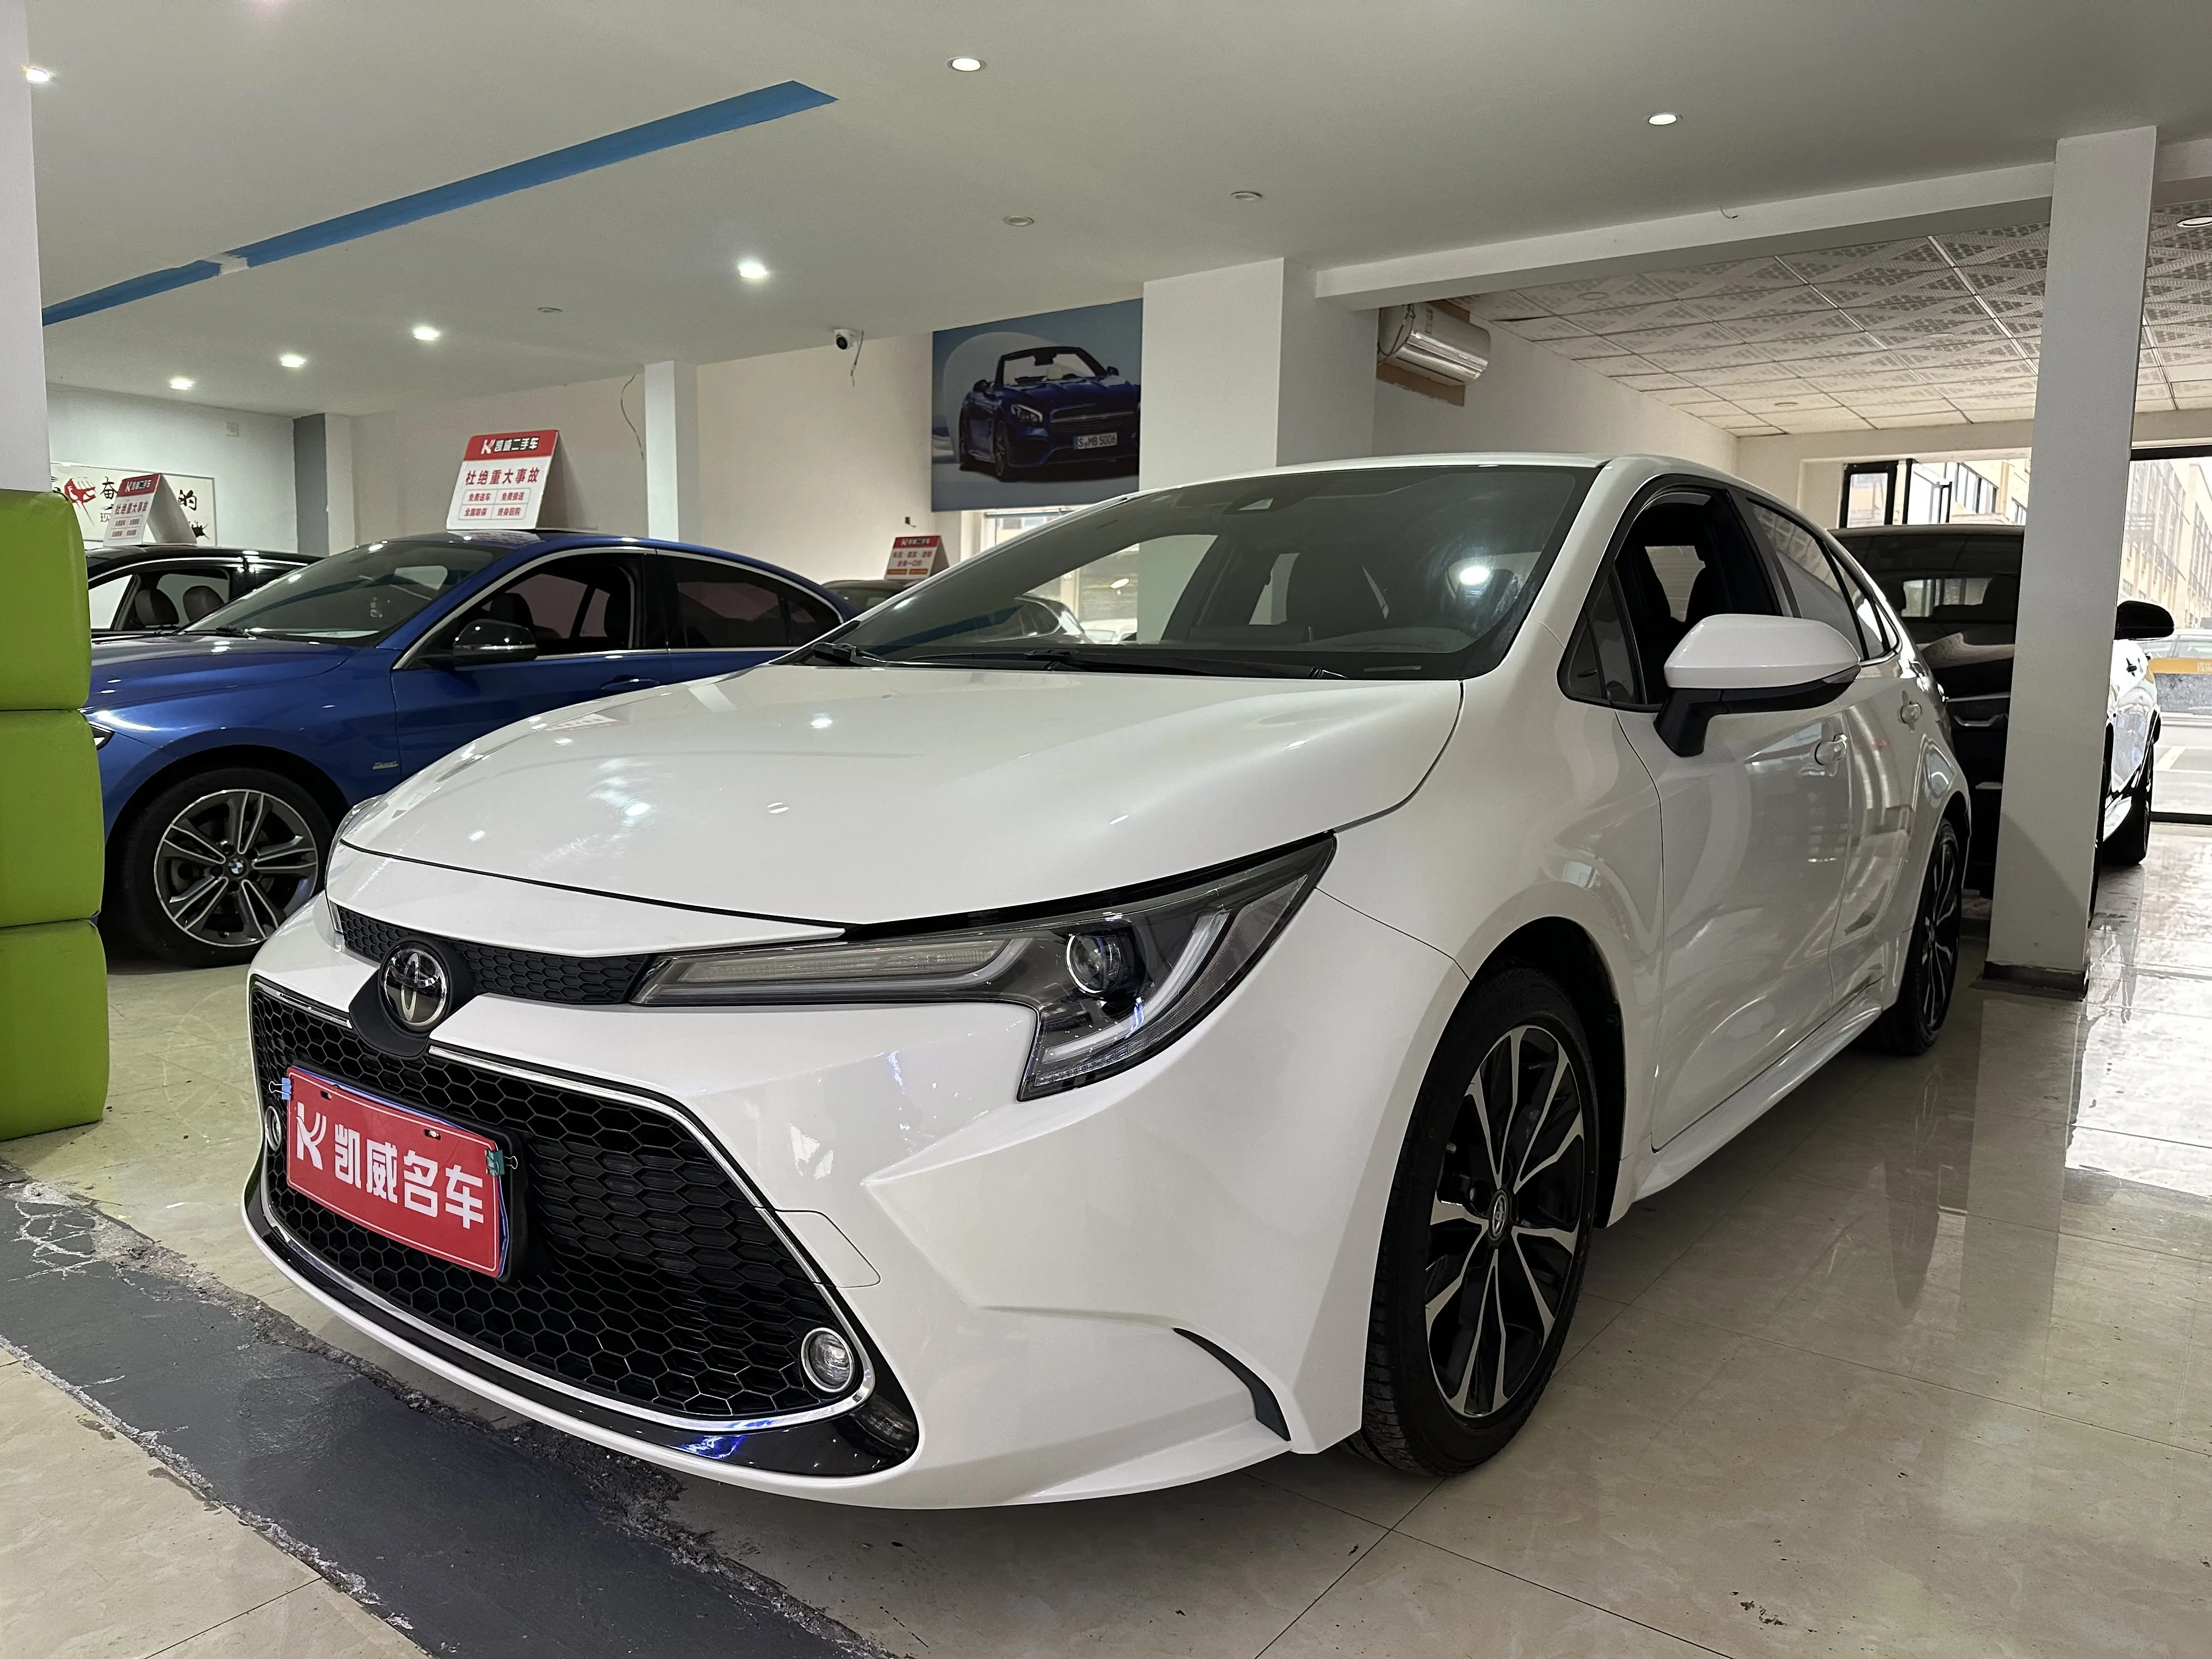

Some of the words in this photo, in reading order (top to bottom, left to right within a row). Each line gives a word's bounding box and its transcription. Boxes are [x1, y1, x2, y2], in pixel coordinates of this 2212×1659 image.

[465, 467, 540, 486] 杜绝重大事故
[334, 1123, 484, 1230] 凯威名车
